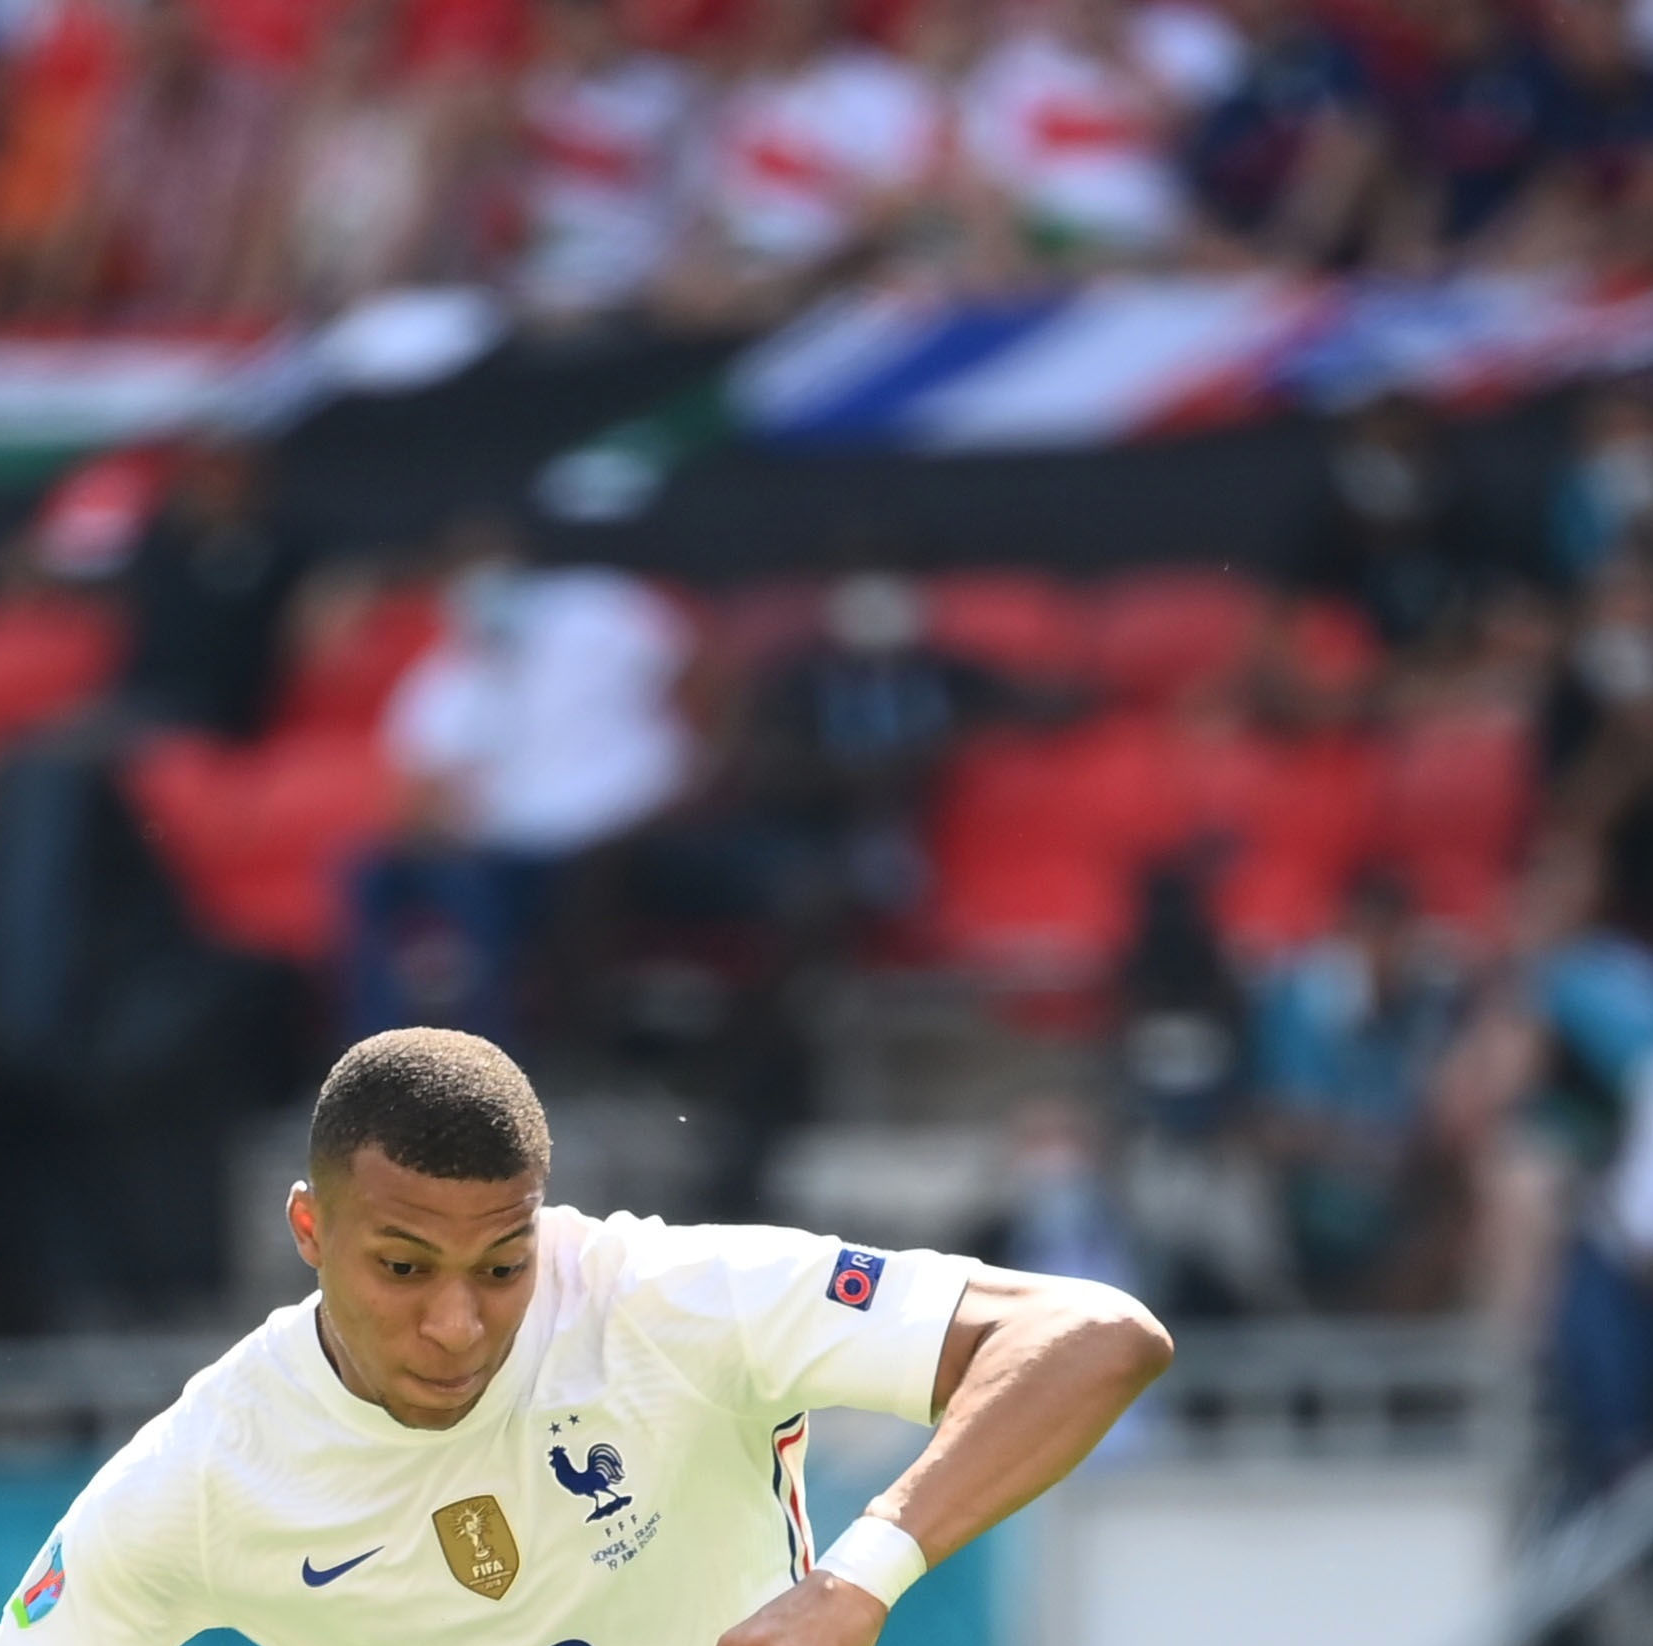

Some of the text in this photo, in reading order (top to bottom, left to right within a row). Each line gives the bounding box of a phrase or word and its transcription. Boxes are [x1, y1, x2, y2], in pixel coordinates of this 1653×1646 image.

[635, 1511, 661, 1540] FRANCE
[472, 1559, 504, 1578] FIFA
[607, 1559, 618, 1572] 19
